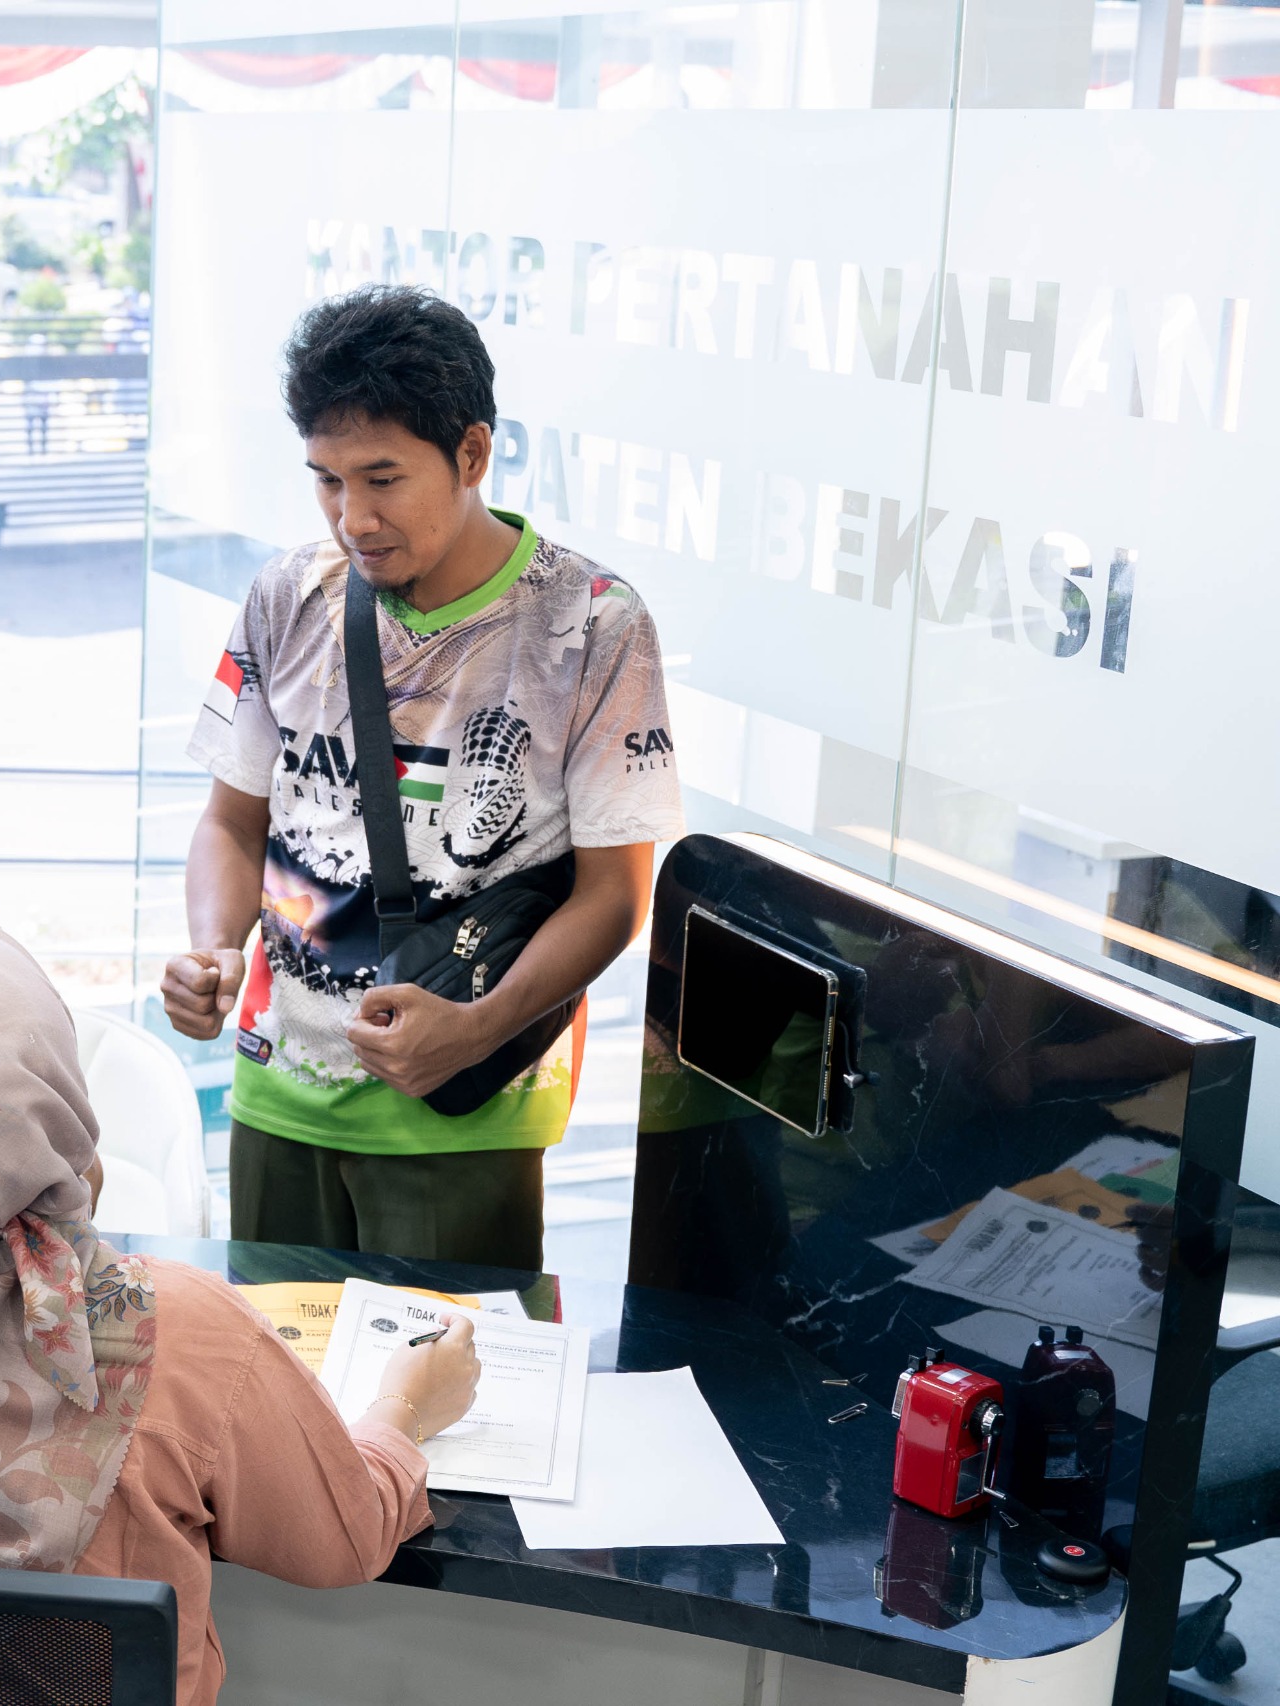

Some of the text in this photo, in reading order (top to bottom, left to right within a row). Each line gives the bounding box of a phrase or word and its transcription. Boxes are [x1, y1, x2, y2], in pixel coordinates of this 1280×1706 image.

[304, 217, 1251, 433] KANTOR PERTANAHAN
[490, 416, 723, 563] PATEN
[750, 468, 1139, 675] BEKASI
[279, 726, 358, 788] SAV
[624, 728, 674, 759] SAV
[626, 758, 669, 774] PALE
[300, 1303, 331, 1319] TIDAK
[406, 1306, 436, 1323] TIDAK
